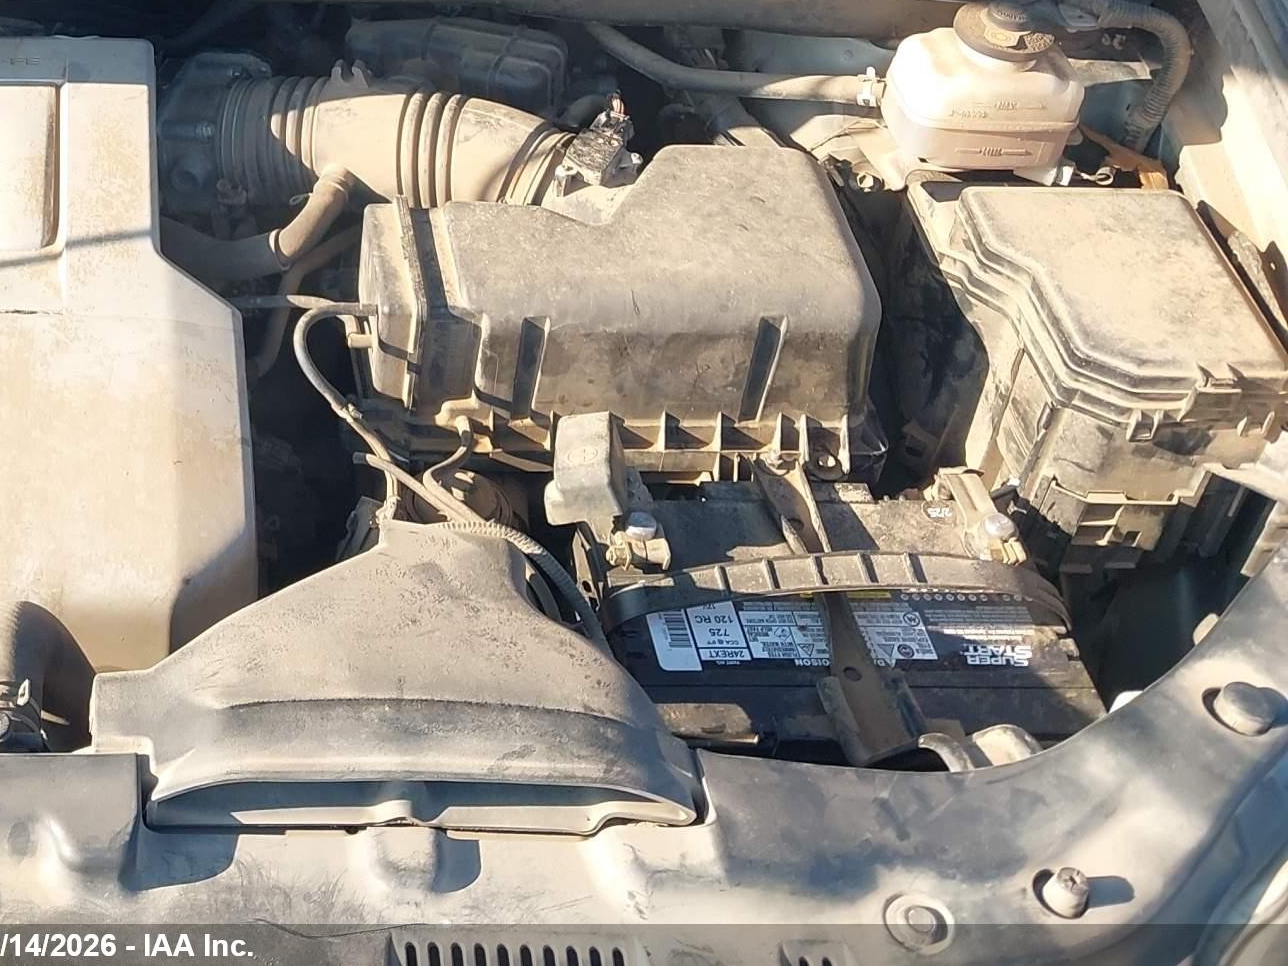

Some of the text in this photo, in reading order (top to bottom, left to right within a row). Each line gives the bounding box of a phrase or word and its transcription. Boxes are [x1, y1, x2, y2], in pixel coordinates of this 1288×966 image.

[694, 614, 734, 624] 120 RC
[708, 627, 730, 637] 725
[708, 648, 745, 659] 24REXT
[964, 645, 1032, 659] START
[794, 658, 830, 667] OISON
[966, 655, 1029, 667] SUPER
